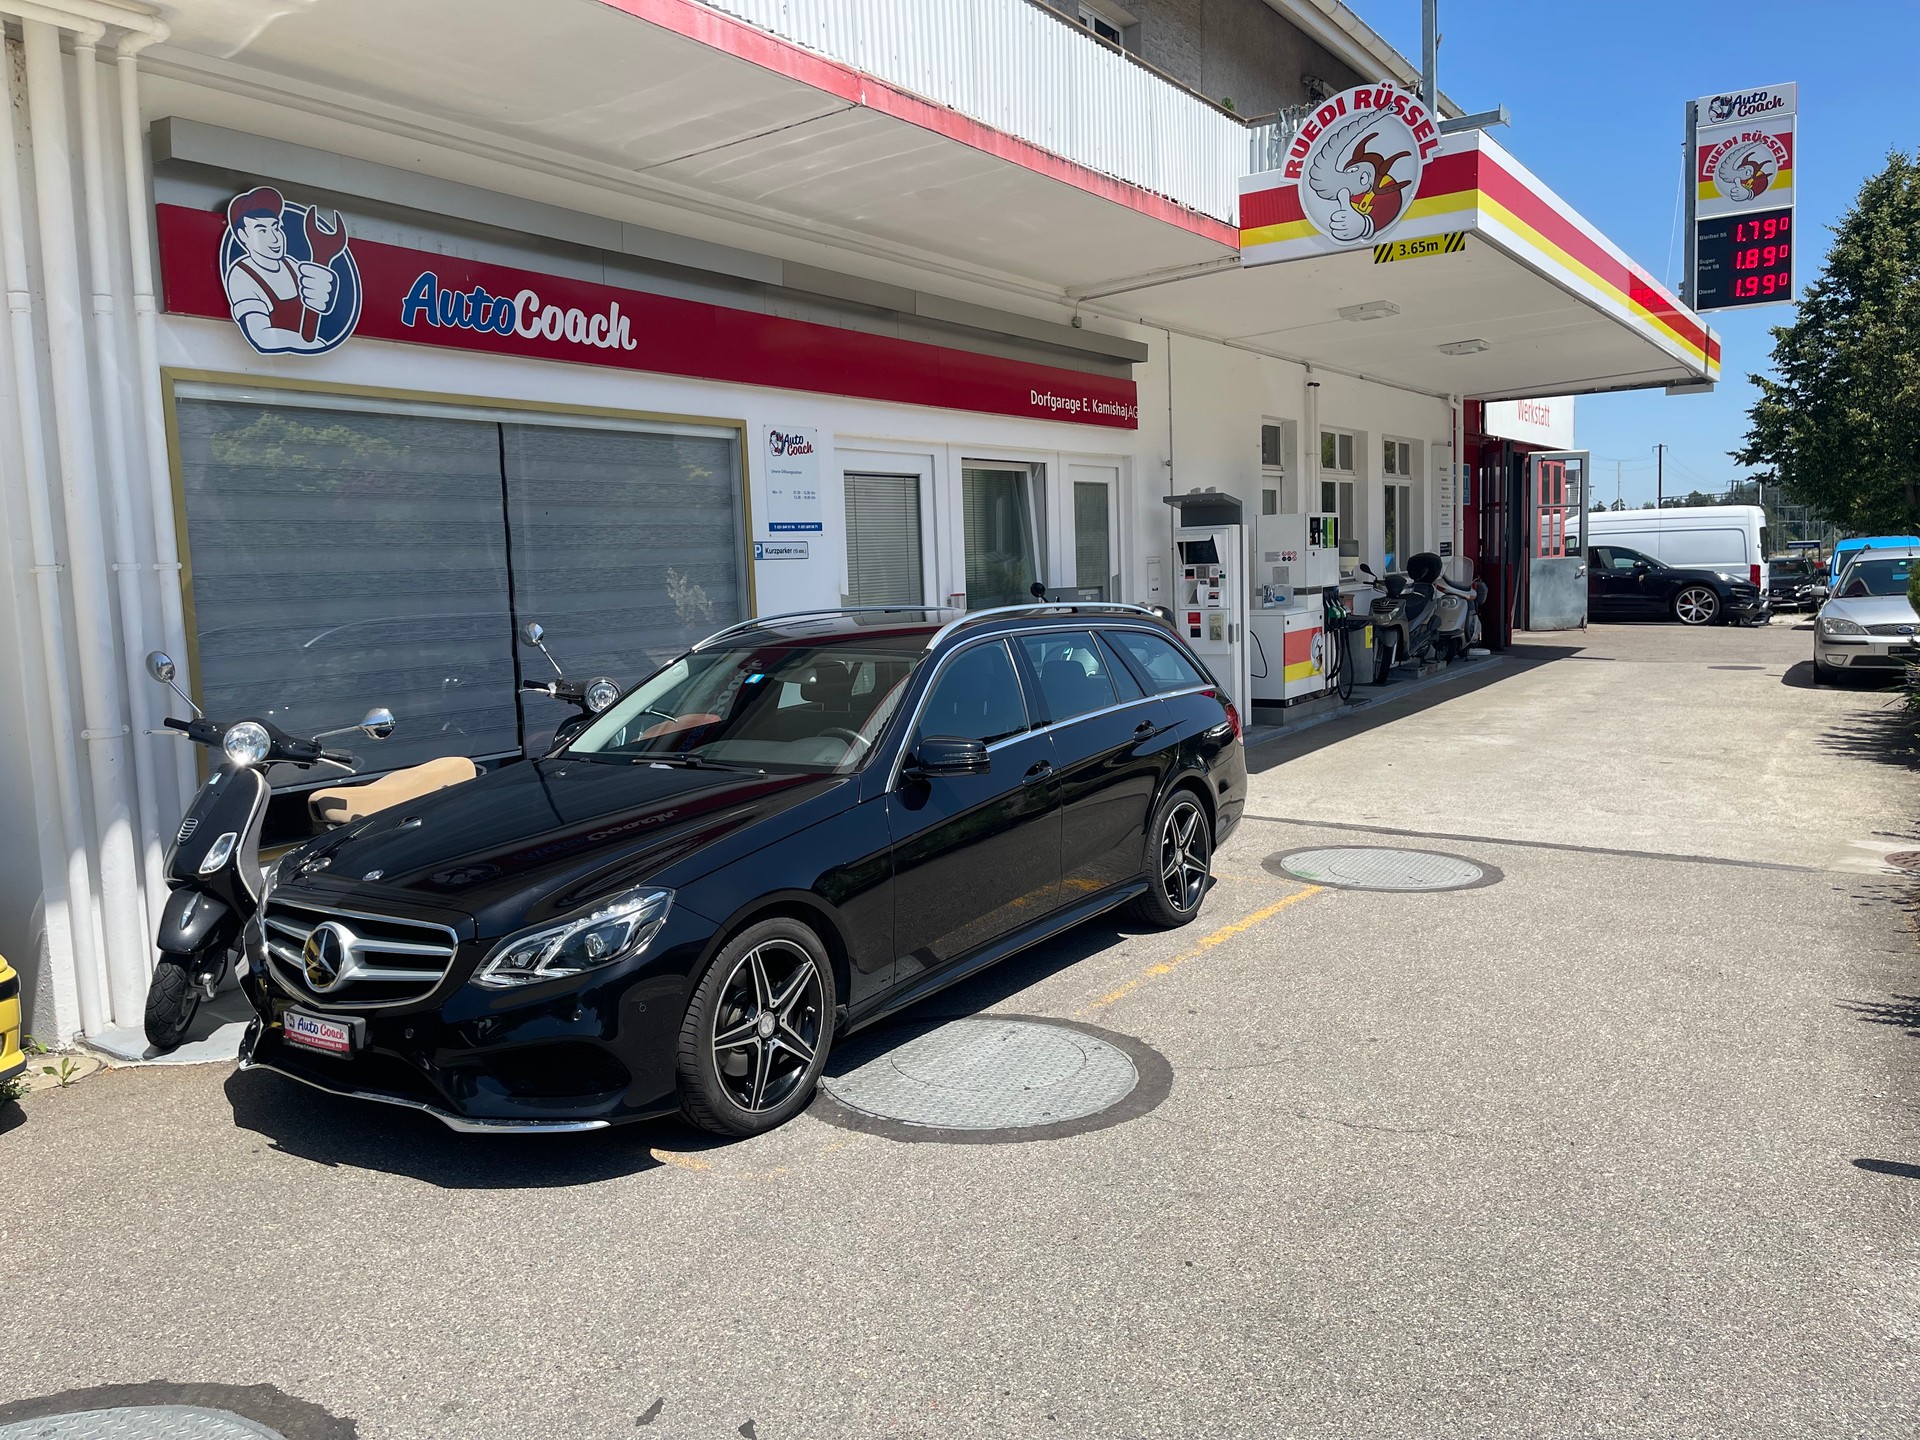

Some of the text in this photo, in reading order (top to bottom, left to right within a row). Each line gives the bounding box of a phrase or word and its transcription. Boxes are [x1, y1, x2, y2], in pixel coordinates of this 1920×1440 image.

[1732, 91, 1768, 109] Auto
[1737, 95, 1785, 117] Coach
[1284, 83, 1440, 179] RUEDI RÜSSEL
[1705, 130, 1787, 177] RUEDI RÜSSEL
[1398, 240, 1440, 256] 3.65m
[1698, 288, 1717, 296] Diesel
[1030, 389, 1081, 414] Dorfgarage
[1082, 397, 1091, 412] E.
[1092, 399, 1128, 420] Kamishaj
[1517, 399, 1550, 428] Werkstatt
[784, 434, 804, 445] Auto
[787, 441, 814, 456] Coach
[754, 544, 762, 558] P
[765, 547, 792, 555] Kurzparker
[297, 1017, 345, 1040] Auto Coach
